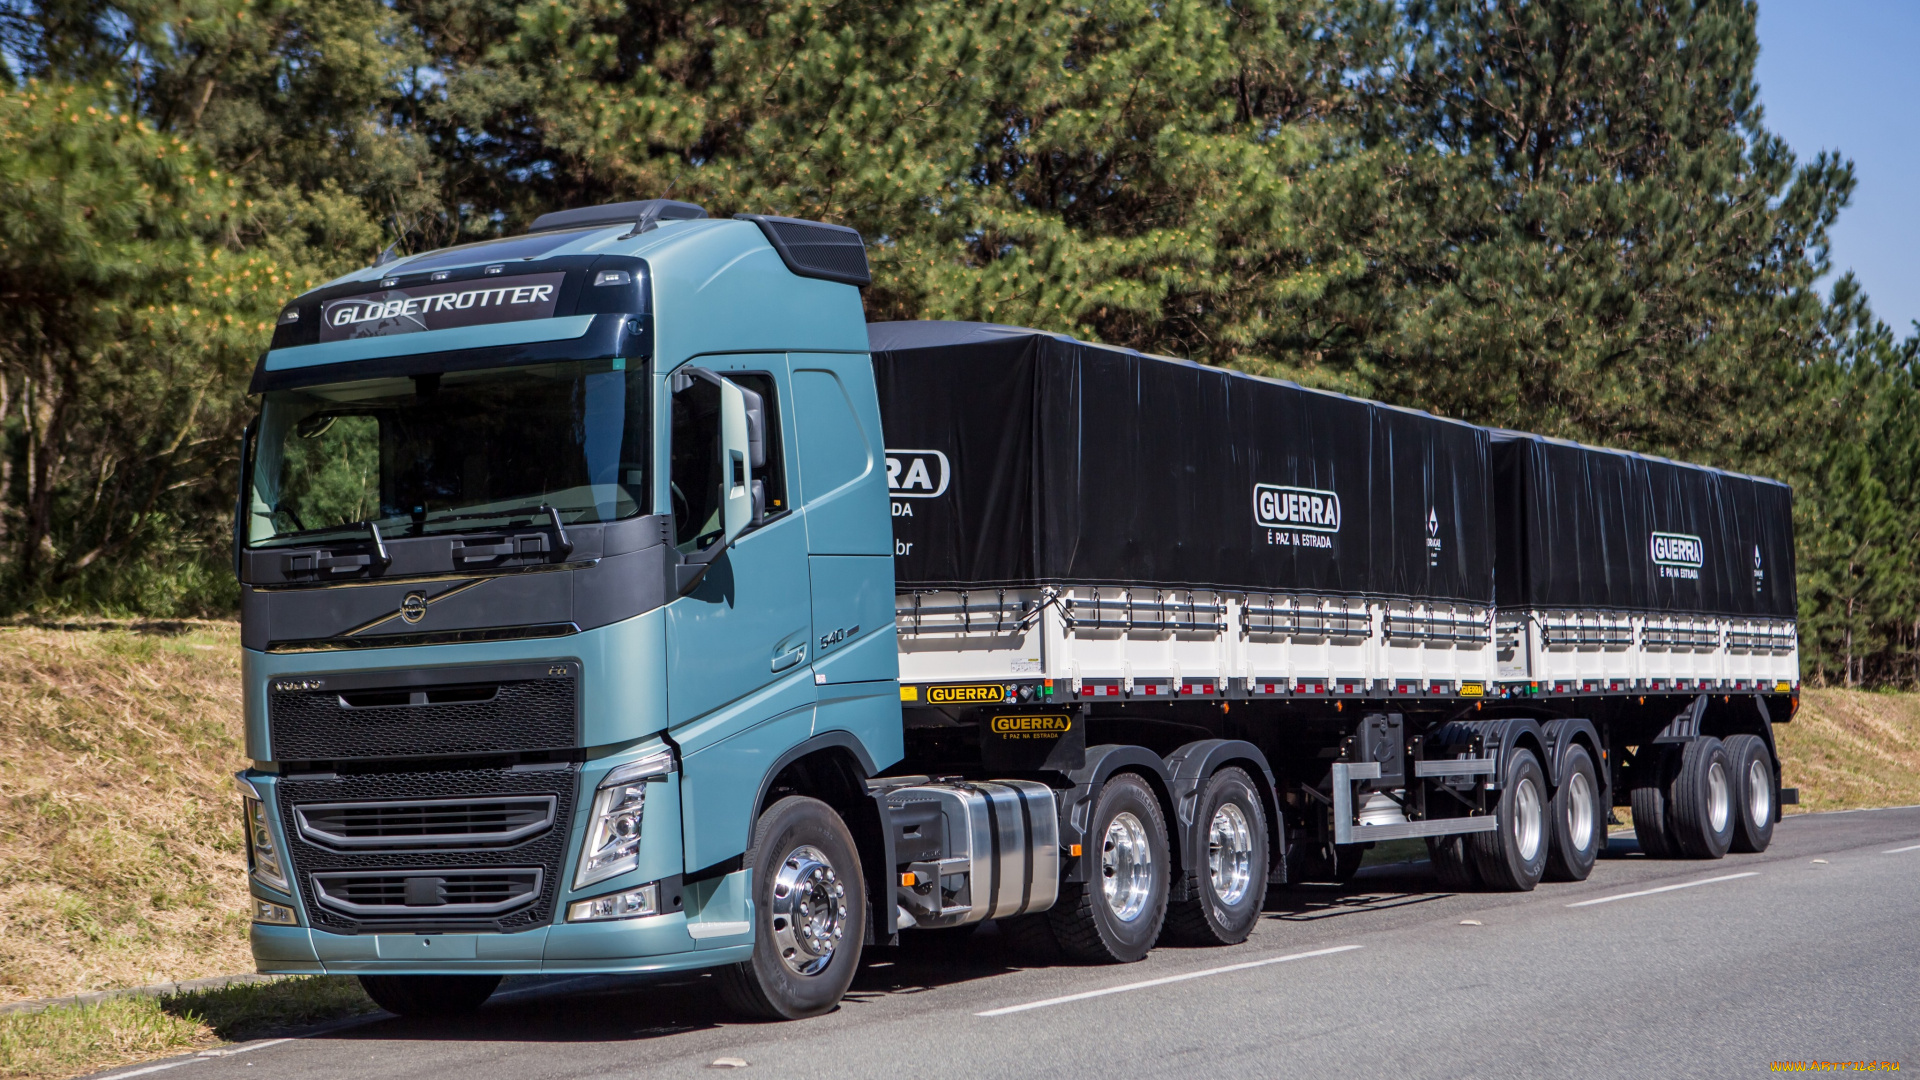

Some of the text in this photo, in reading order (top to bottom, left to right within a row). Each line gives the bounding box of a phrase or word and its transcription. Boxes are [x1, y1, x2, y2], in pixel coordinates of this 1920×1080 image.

[333, 284, 554, 326] GLOBETROTTER
[1260, 491, 1337, 525] GUERRA
[1267, 529, 1273, 545] É
[1275, 532, 1290, 545] PAZ
[1301, 534, 1332, 548] ESTRADA
[1655, 537, 1700, 562] GUERRA
[820, 628, 844, 650] 540
[275, 680, 320, 691] VOLVO
[932, 687, 999, 700] GUERRA
[1462, 685, 1481, 694] GUERRA
[997, 718, 1065, 730] GUERRA
